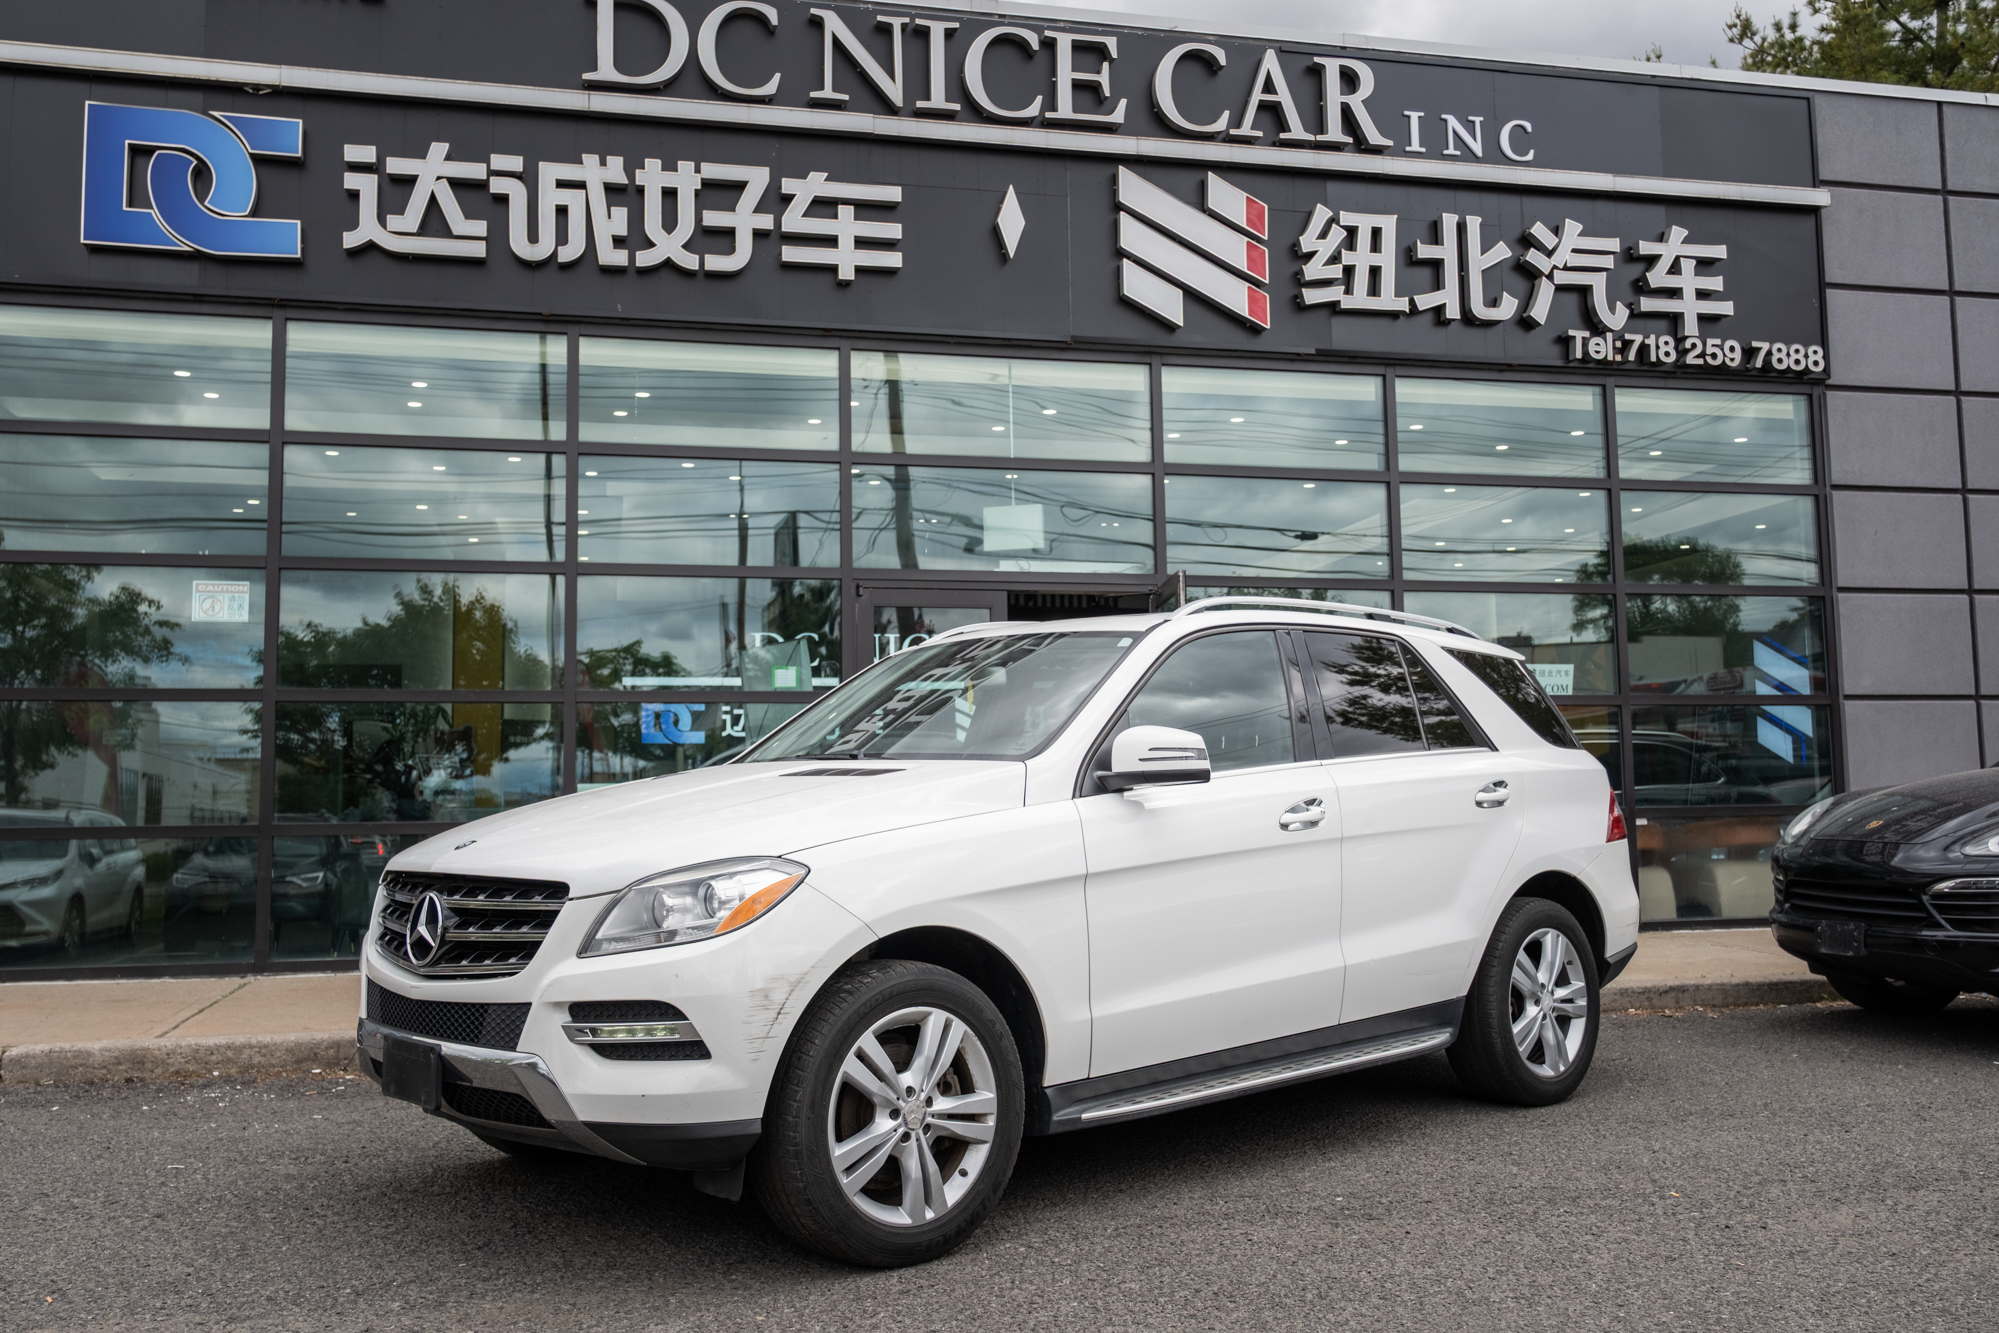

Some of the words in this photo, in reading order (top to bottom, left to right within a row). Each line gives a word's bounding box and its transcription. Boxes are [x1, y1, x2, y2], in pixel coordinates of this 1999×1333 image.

[581, 0, 782, 102] DC
[808, 7, 1129, 128] NICE
[1152, 42, 1394, 150] CAR
[1403, 110, 1536, 162] INC
[342, 141, 904, 284] 达诚好车
[1297, 202, 1735, 336] 纽北汽车
[1683, 336, 1743, 367] 259
[1748, 340, 1827, 373] 7888
[198, 584, 248, 592] CAUTION
